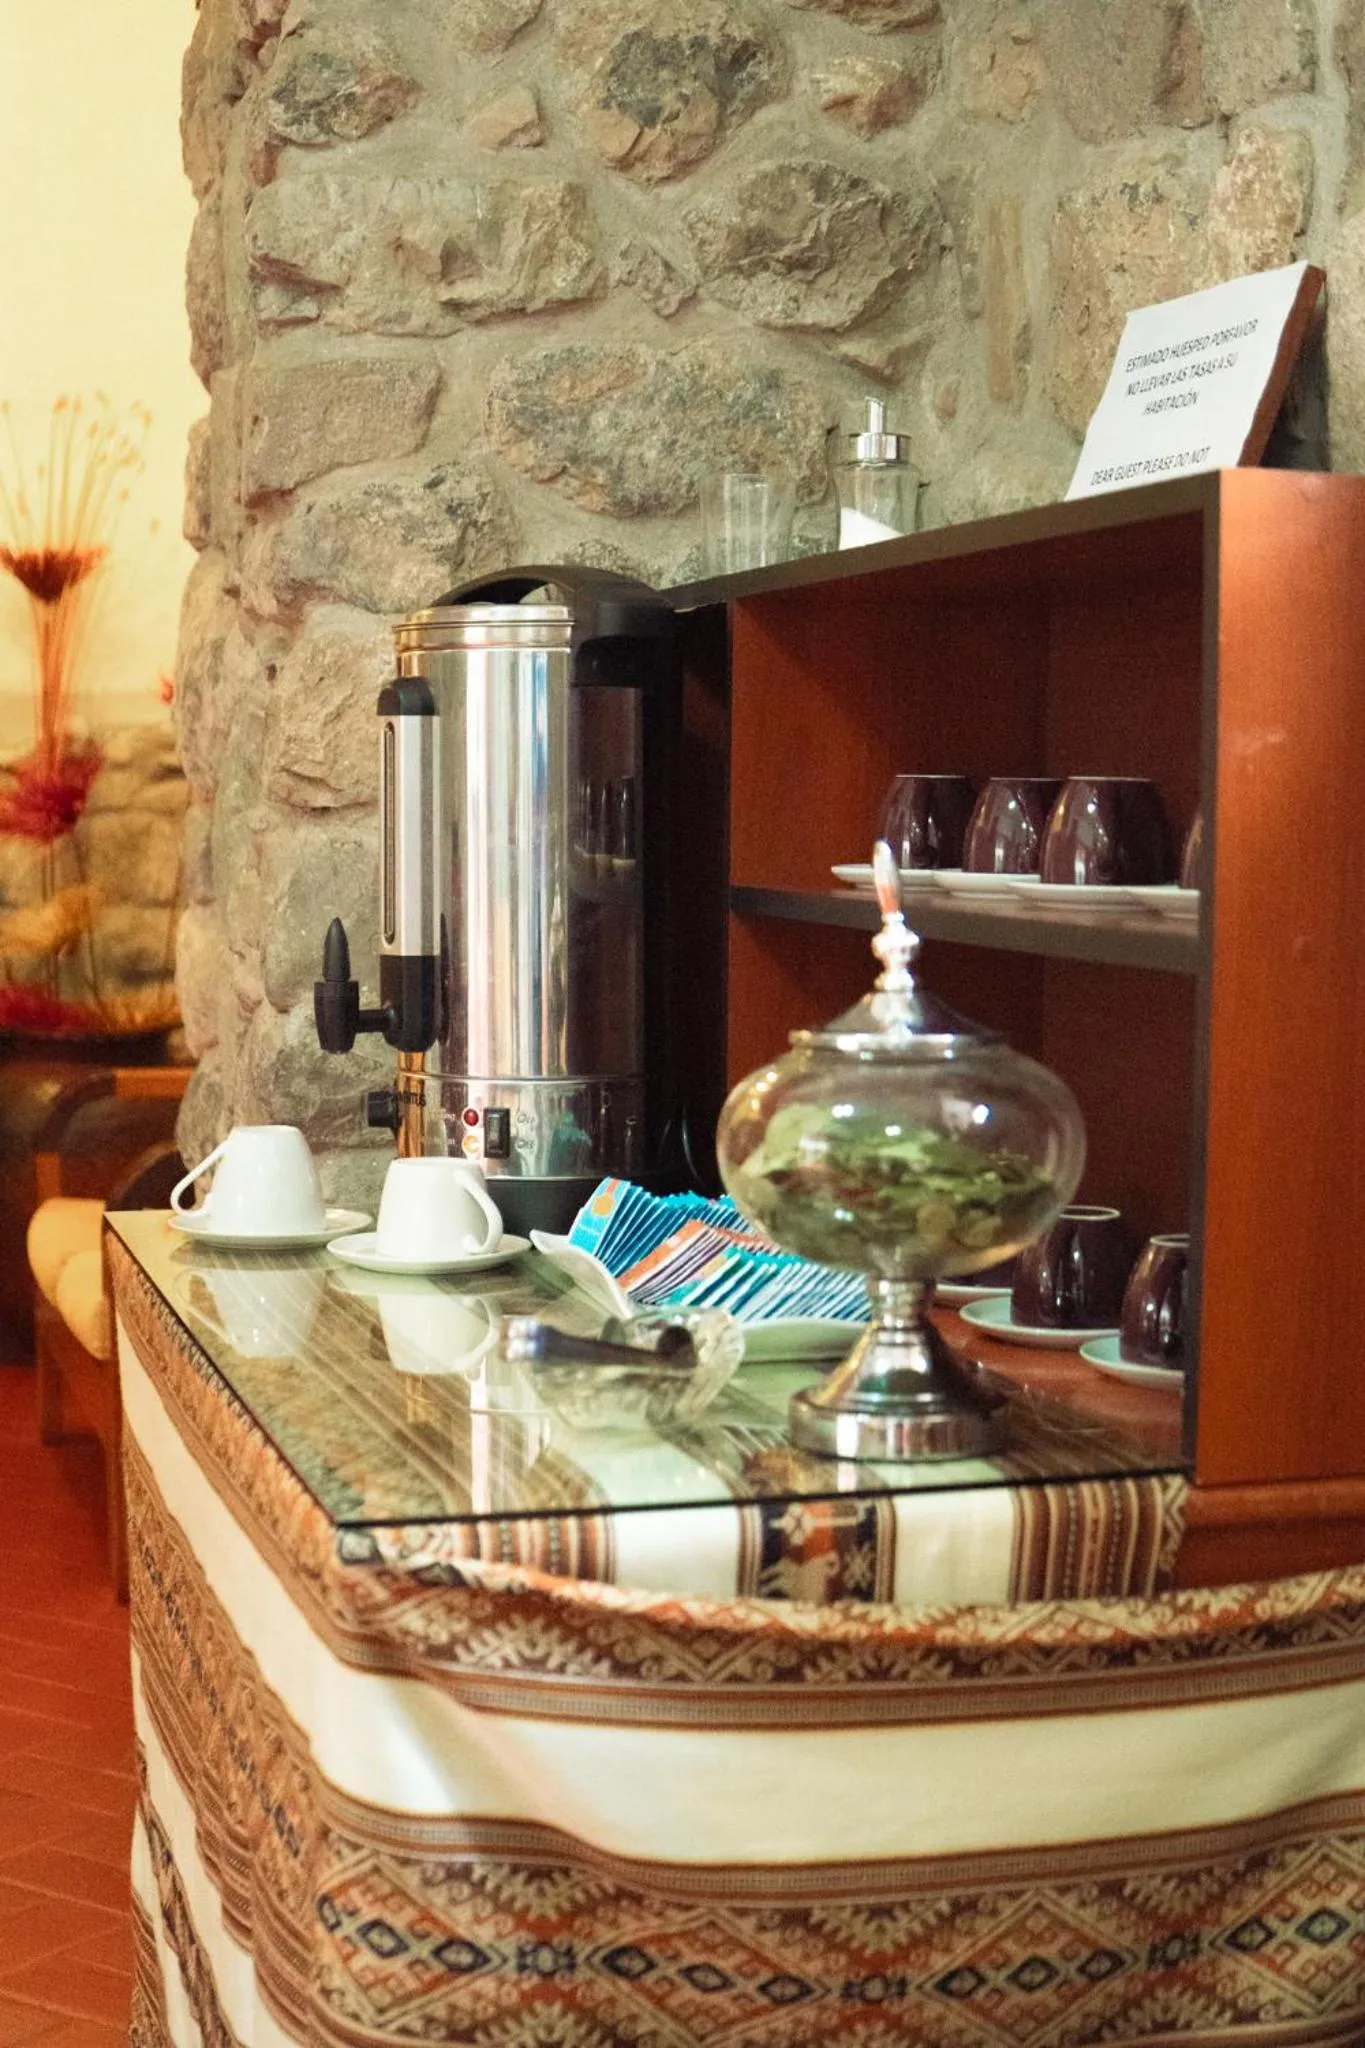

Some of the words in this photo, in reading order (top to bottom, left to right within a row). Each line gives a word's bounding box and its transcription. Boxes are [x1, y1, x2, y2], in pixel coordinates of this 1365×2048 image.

[1126, 346, 1169, 373] ESTIMADO
[1169, 335, 1210, 359] HUESPED
[1211, 319, 1258, 347] PORFAVOR
[1126, 381, 1141, 396] NO
[1140, 371, 1172, 393] LLEVAR
[1170, 367, 1187, 384] LAS
[1189, 359, 1218, 379] TASAS
[1224, 351, 1239, 369] SU
[1144, 389, 1198, 415] HABITACIÓN
[1091, 468, 1114, 485] DEAR
[1113, 462, 1143, 480] GUEST
[1142, 455, 1174, 474] PLEASE
[1173, 452, 1190, 468] DO
[1190, 446, 1211, 465] NOT
